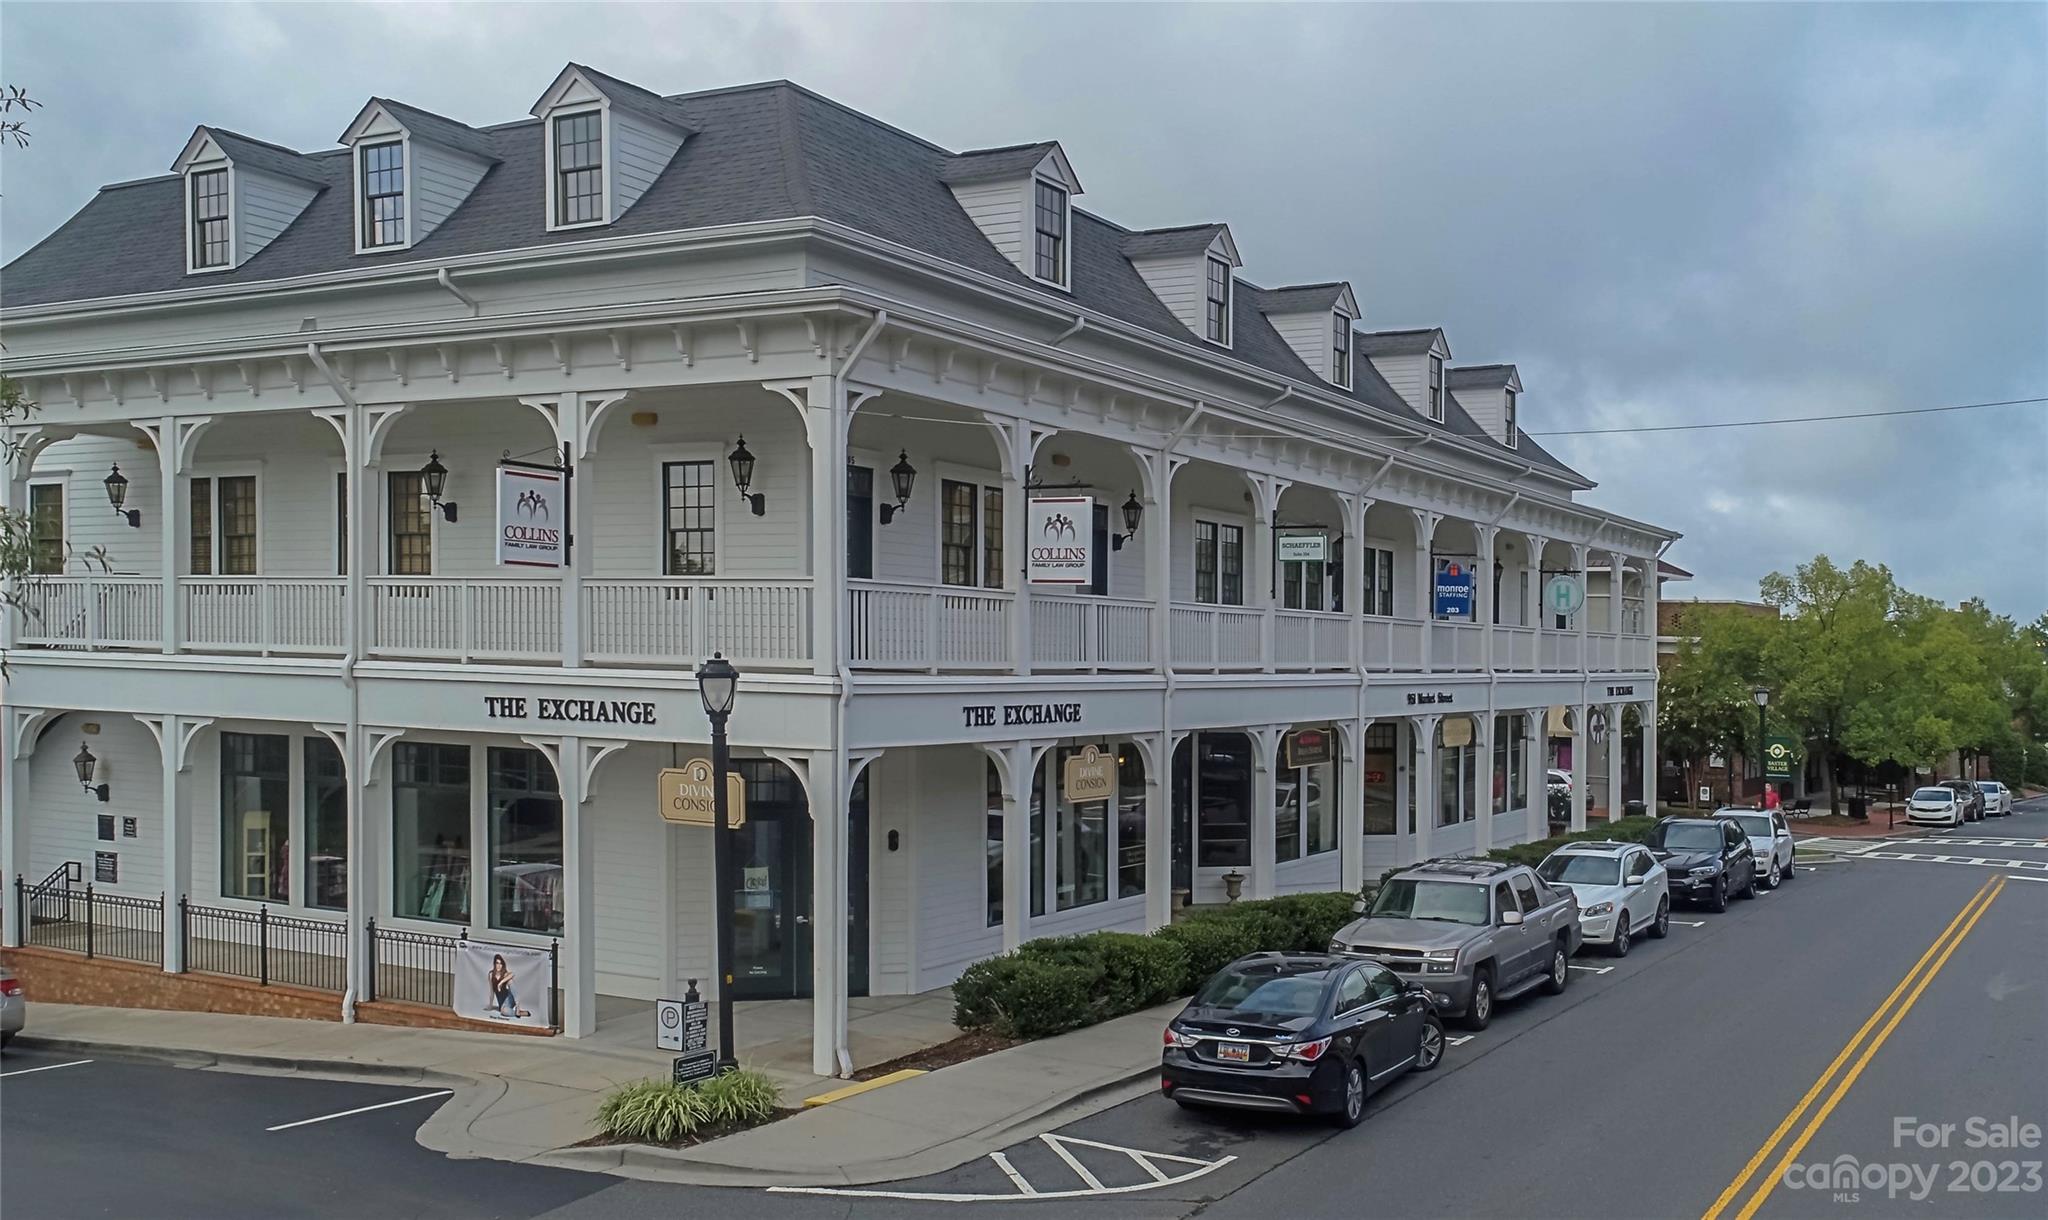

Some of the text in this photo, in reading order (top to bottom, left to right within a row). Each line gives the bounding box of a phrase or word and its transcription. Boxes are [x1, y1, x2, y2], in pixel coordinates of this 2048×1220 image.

[504, 525, 559, 543] COLLINS
[1031, 547, 1086, 560] COLLINS
[1437, 585, 1469, 593] monroe
[1556, 585, 1570, 607] H
[484, 696, 657, 725] THE EXCHANGE
[962, 703, 1082, 727] THE EXCHANGE
[680, 783, 715, 798] DIVIN
[666, 1010, 676, 1025] P
